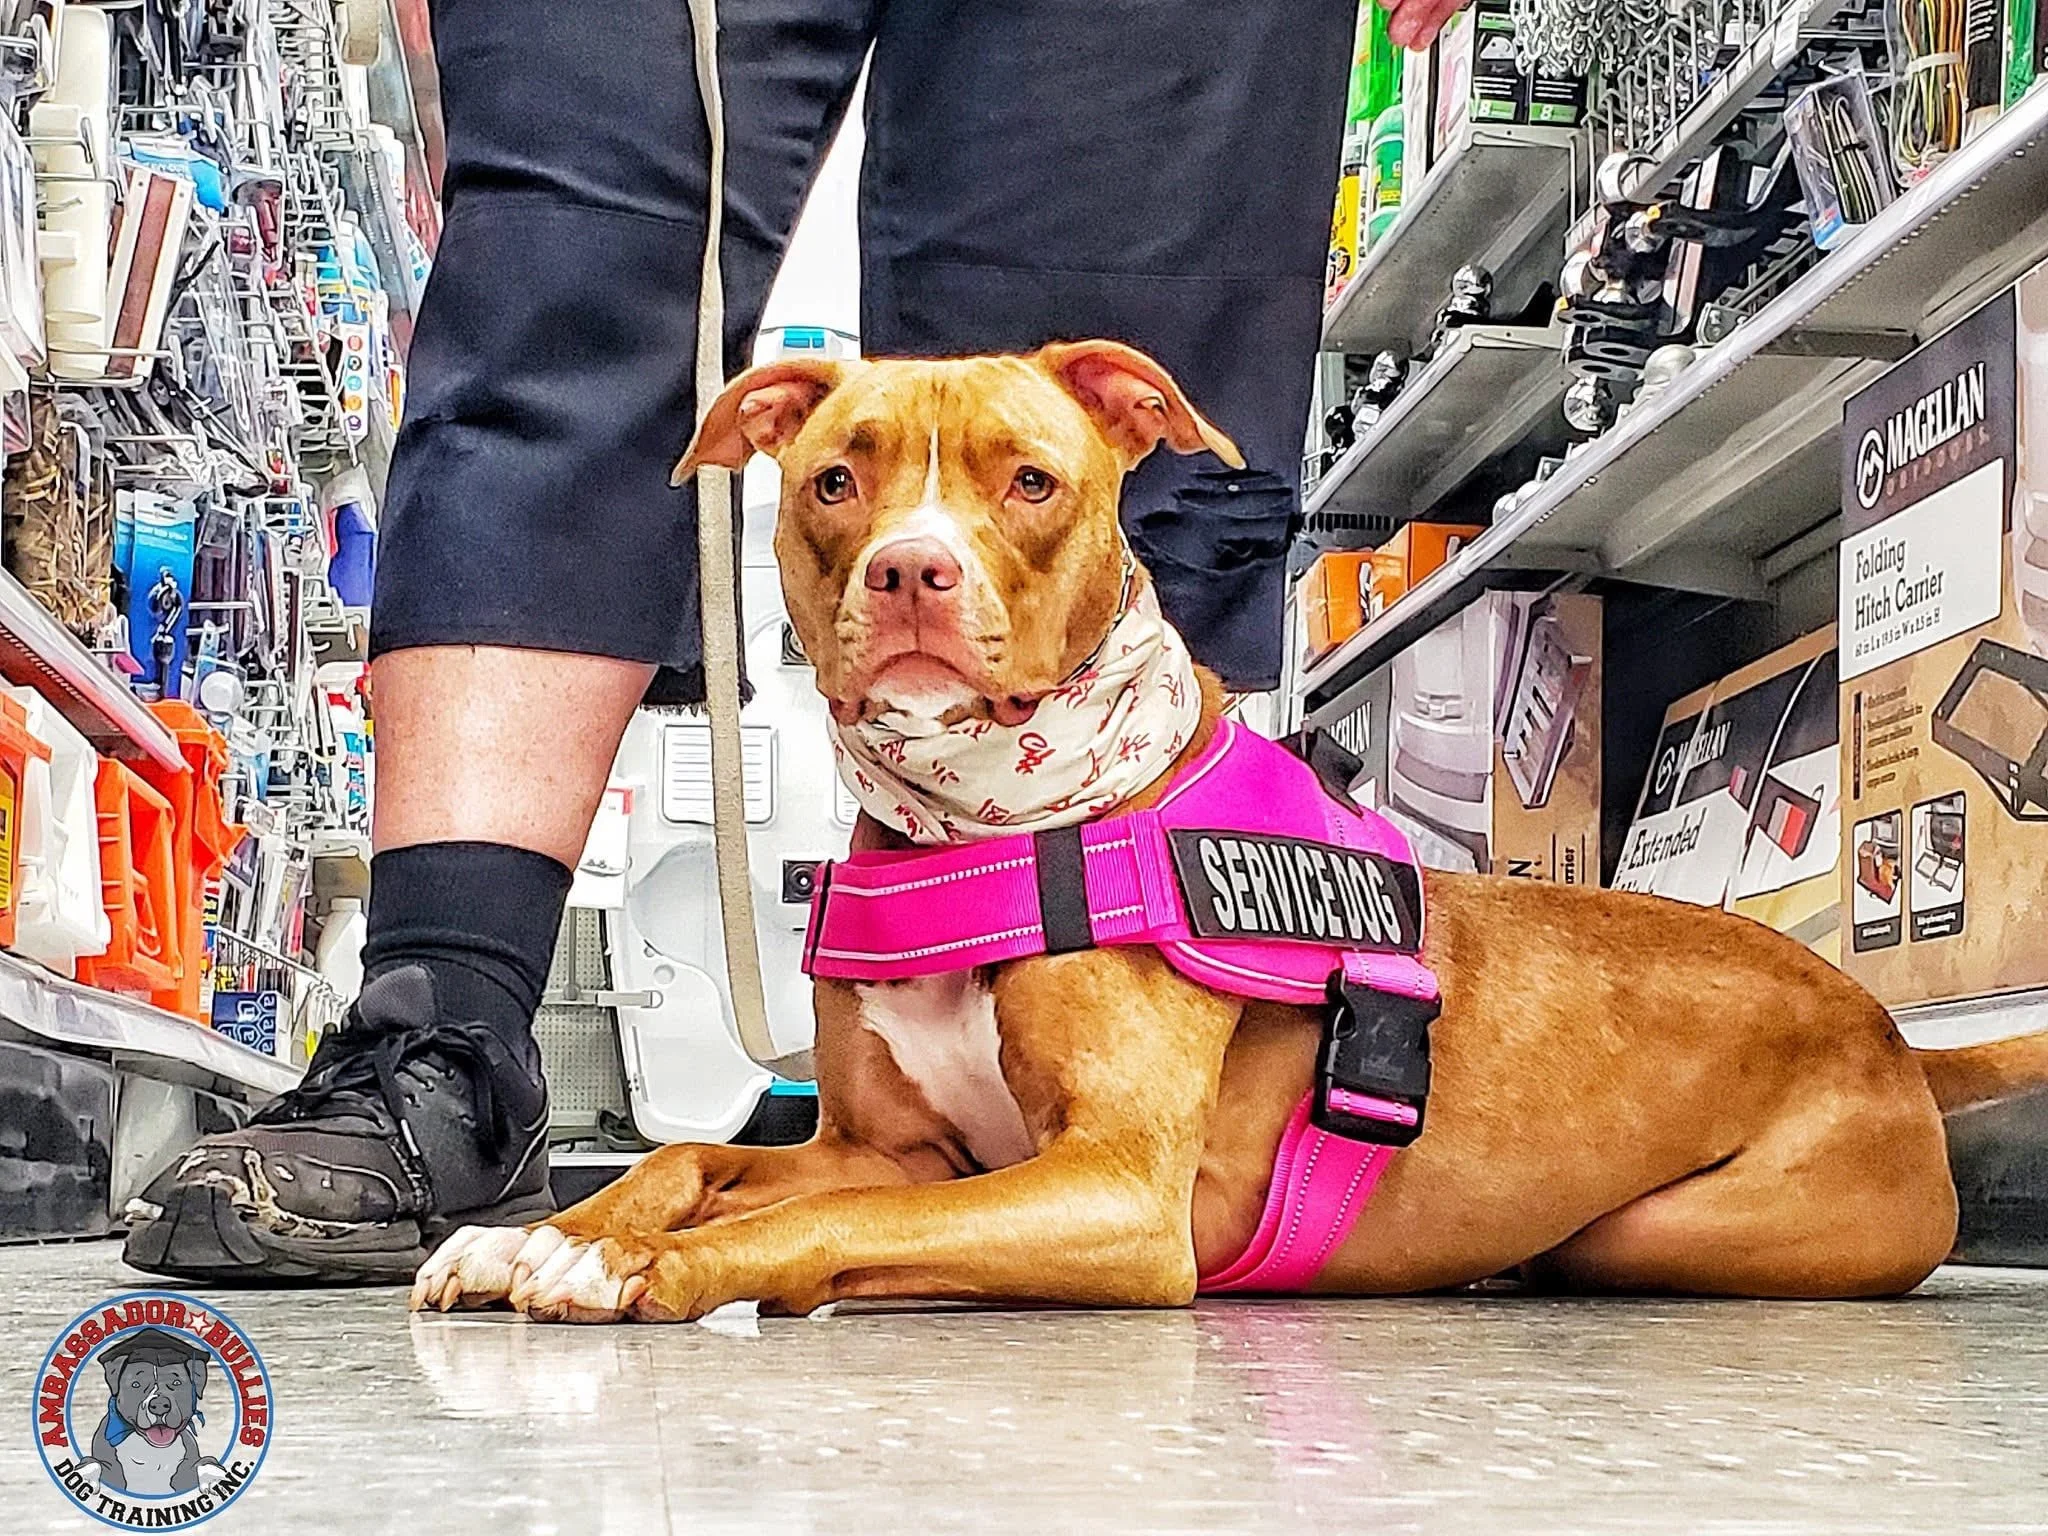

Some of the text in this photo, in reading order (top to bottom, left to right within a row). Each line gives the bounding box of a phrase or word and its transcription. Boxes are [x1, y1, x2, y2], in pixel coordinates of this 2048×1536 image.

[1886, 361, 1986, 474] MAGELLAN
[1855, 536, 1907, 584] Folding
[1855, 564, 1945, 632] Hitch Carrier
[1628, 806, 1708, 870] Extended
[1199, 837, 1402, 946] SERVICE DOG
